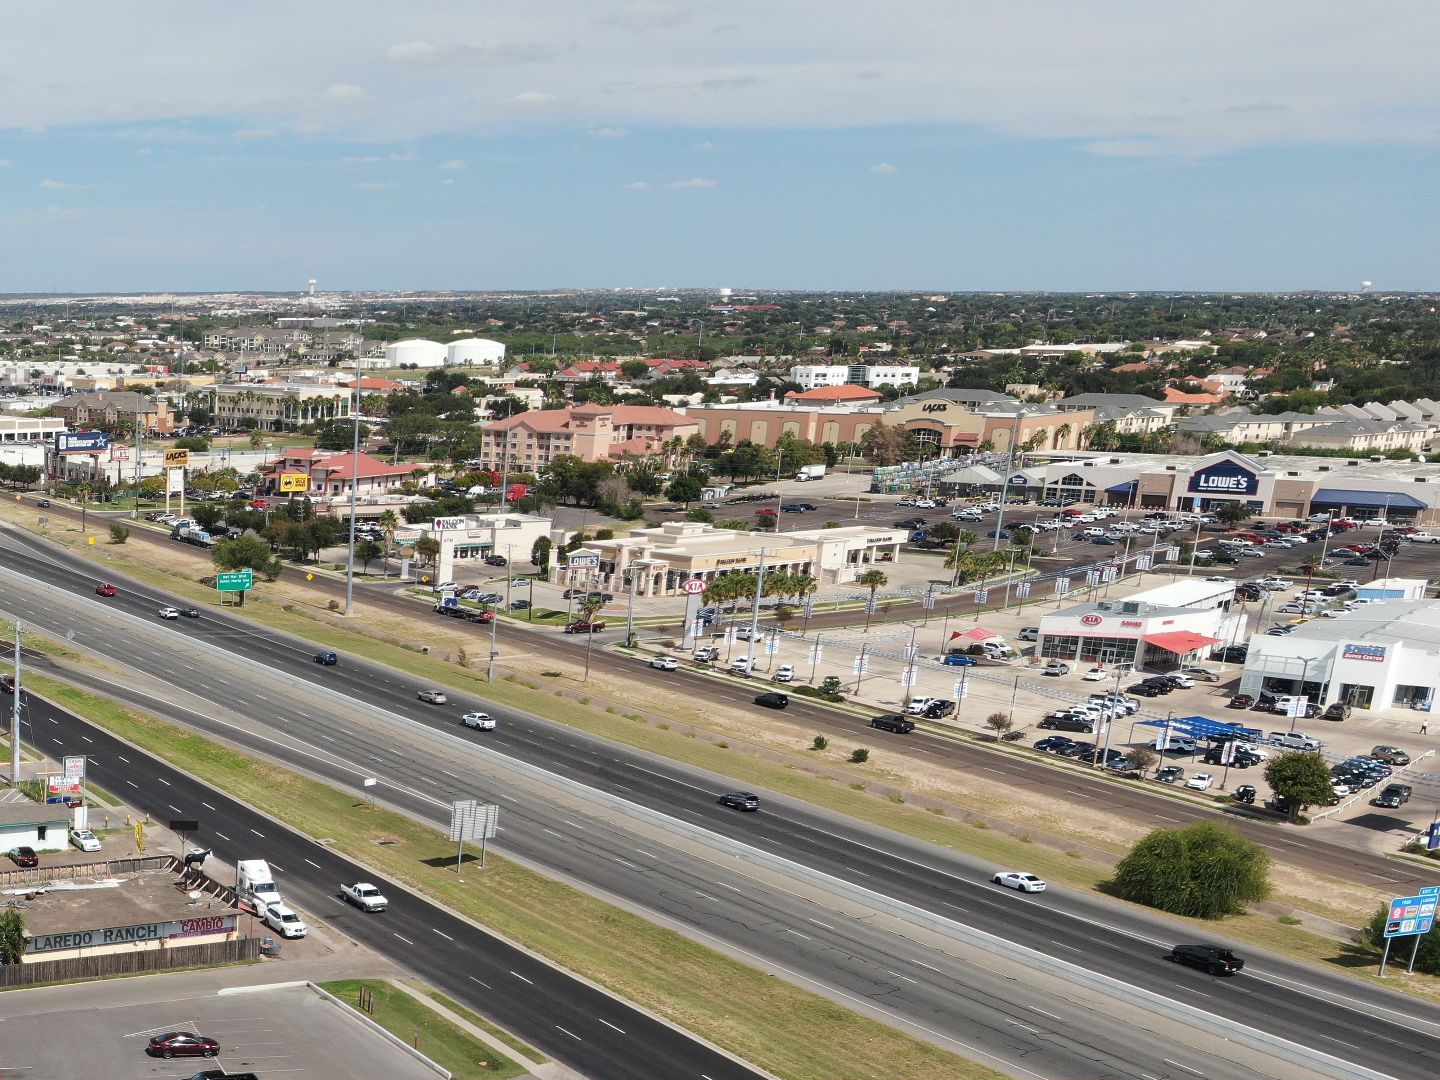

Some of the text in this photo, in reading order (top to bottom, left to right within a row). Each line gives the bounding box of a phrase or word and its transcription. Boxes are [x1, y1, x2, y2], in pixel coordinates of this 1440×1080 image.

[922, 403, 948, 413] LACKS
[1199, 474, 1248, 488] LOWE'S
[569, 556, 598, 566] LOWE'S
[688, 582, 702, 591] KIA
[1084, 616, 1100, 625] KIA
[181, 920, 224, 933] CAMBIO
[34, 925, 158, 951] LAREDO RANCH
